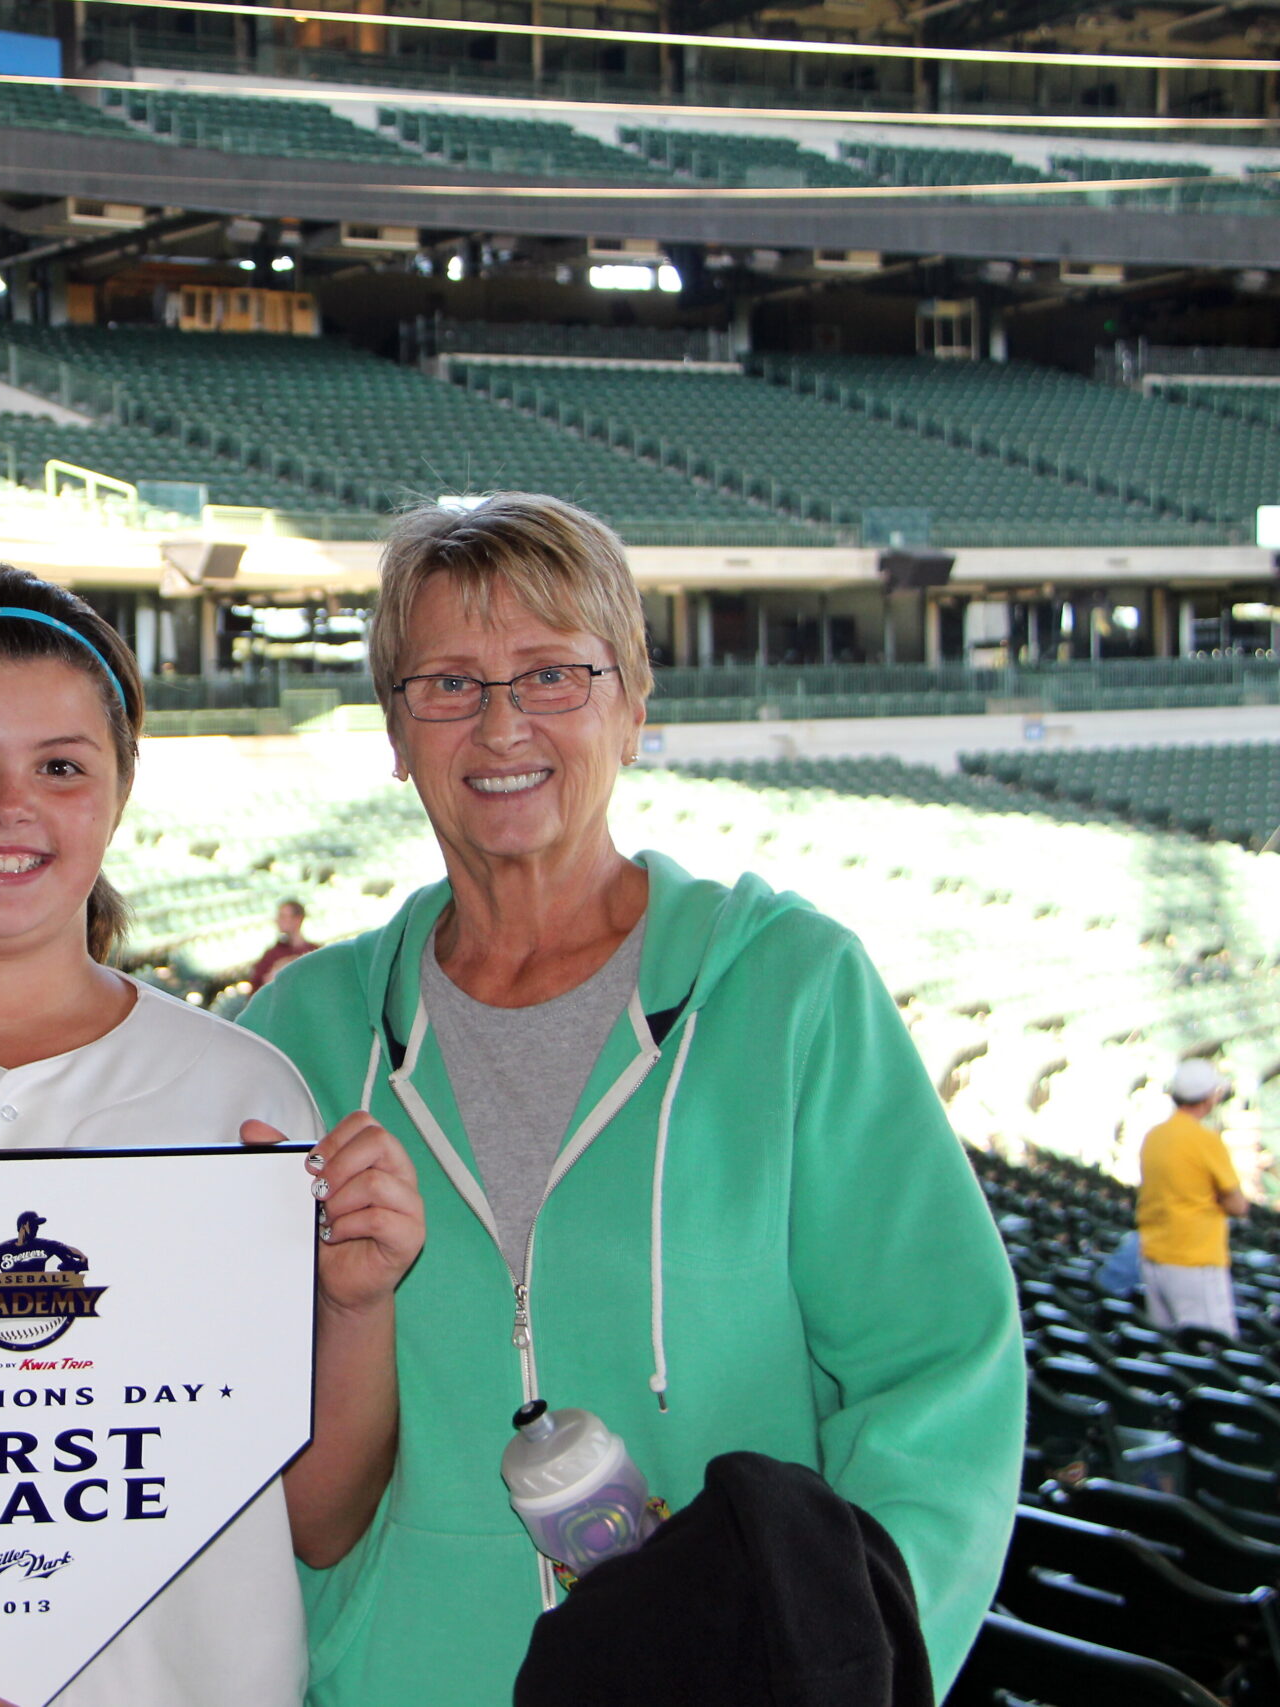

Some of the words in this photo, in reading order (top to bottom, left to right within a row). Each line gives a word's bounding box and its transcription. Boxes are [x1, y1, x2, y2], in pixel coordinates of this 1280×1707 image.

[19, 1358, 59, 1371] KWIK
[60, 1357, 94, 1370] TRIP
[124, 1384, 205, 1404] DAY
[18, 1550, 72, 1578] Park
